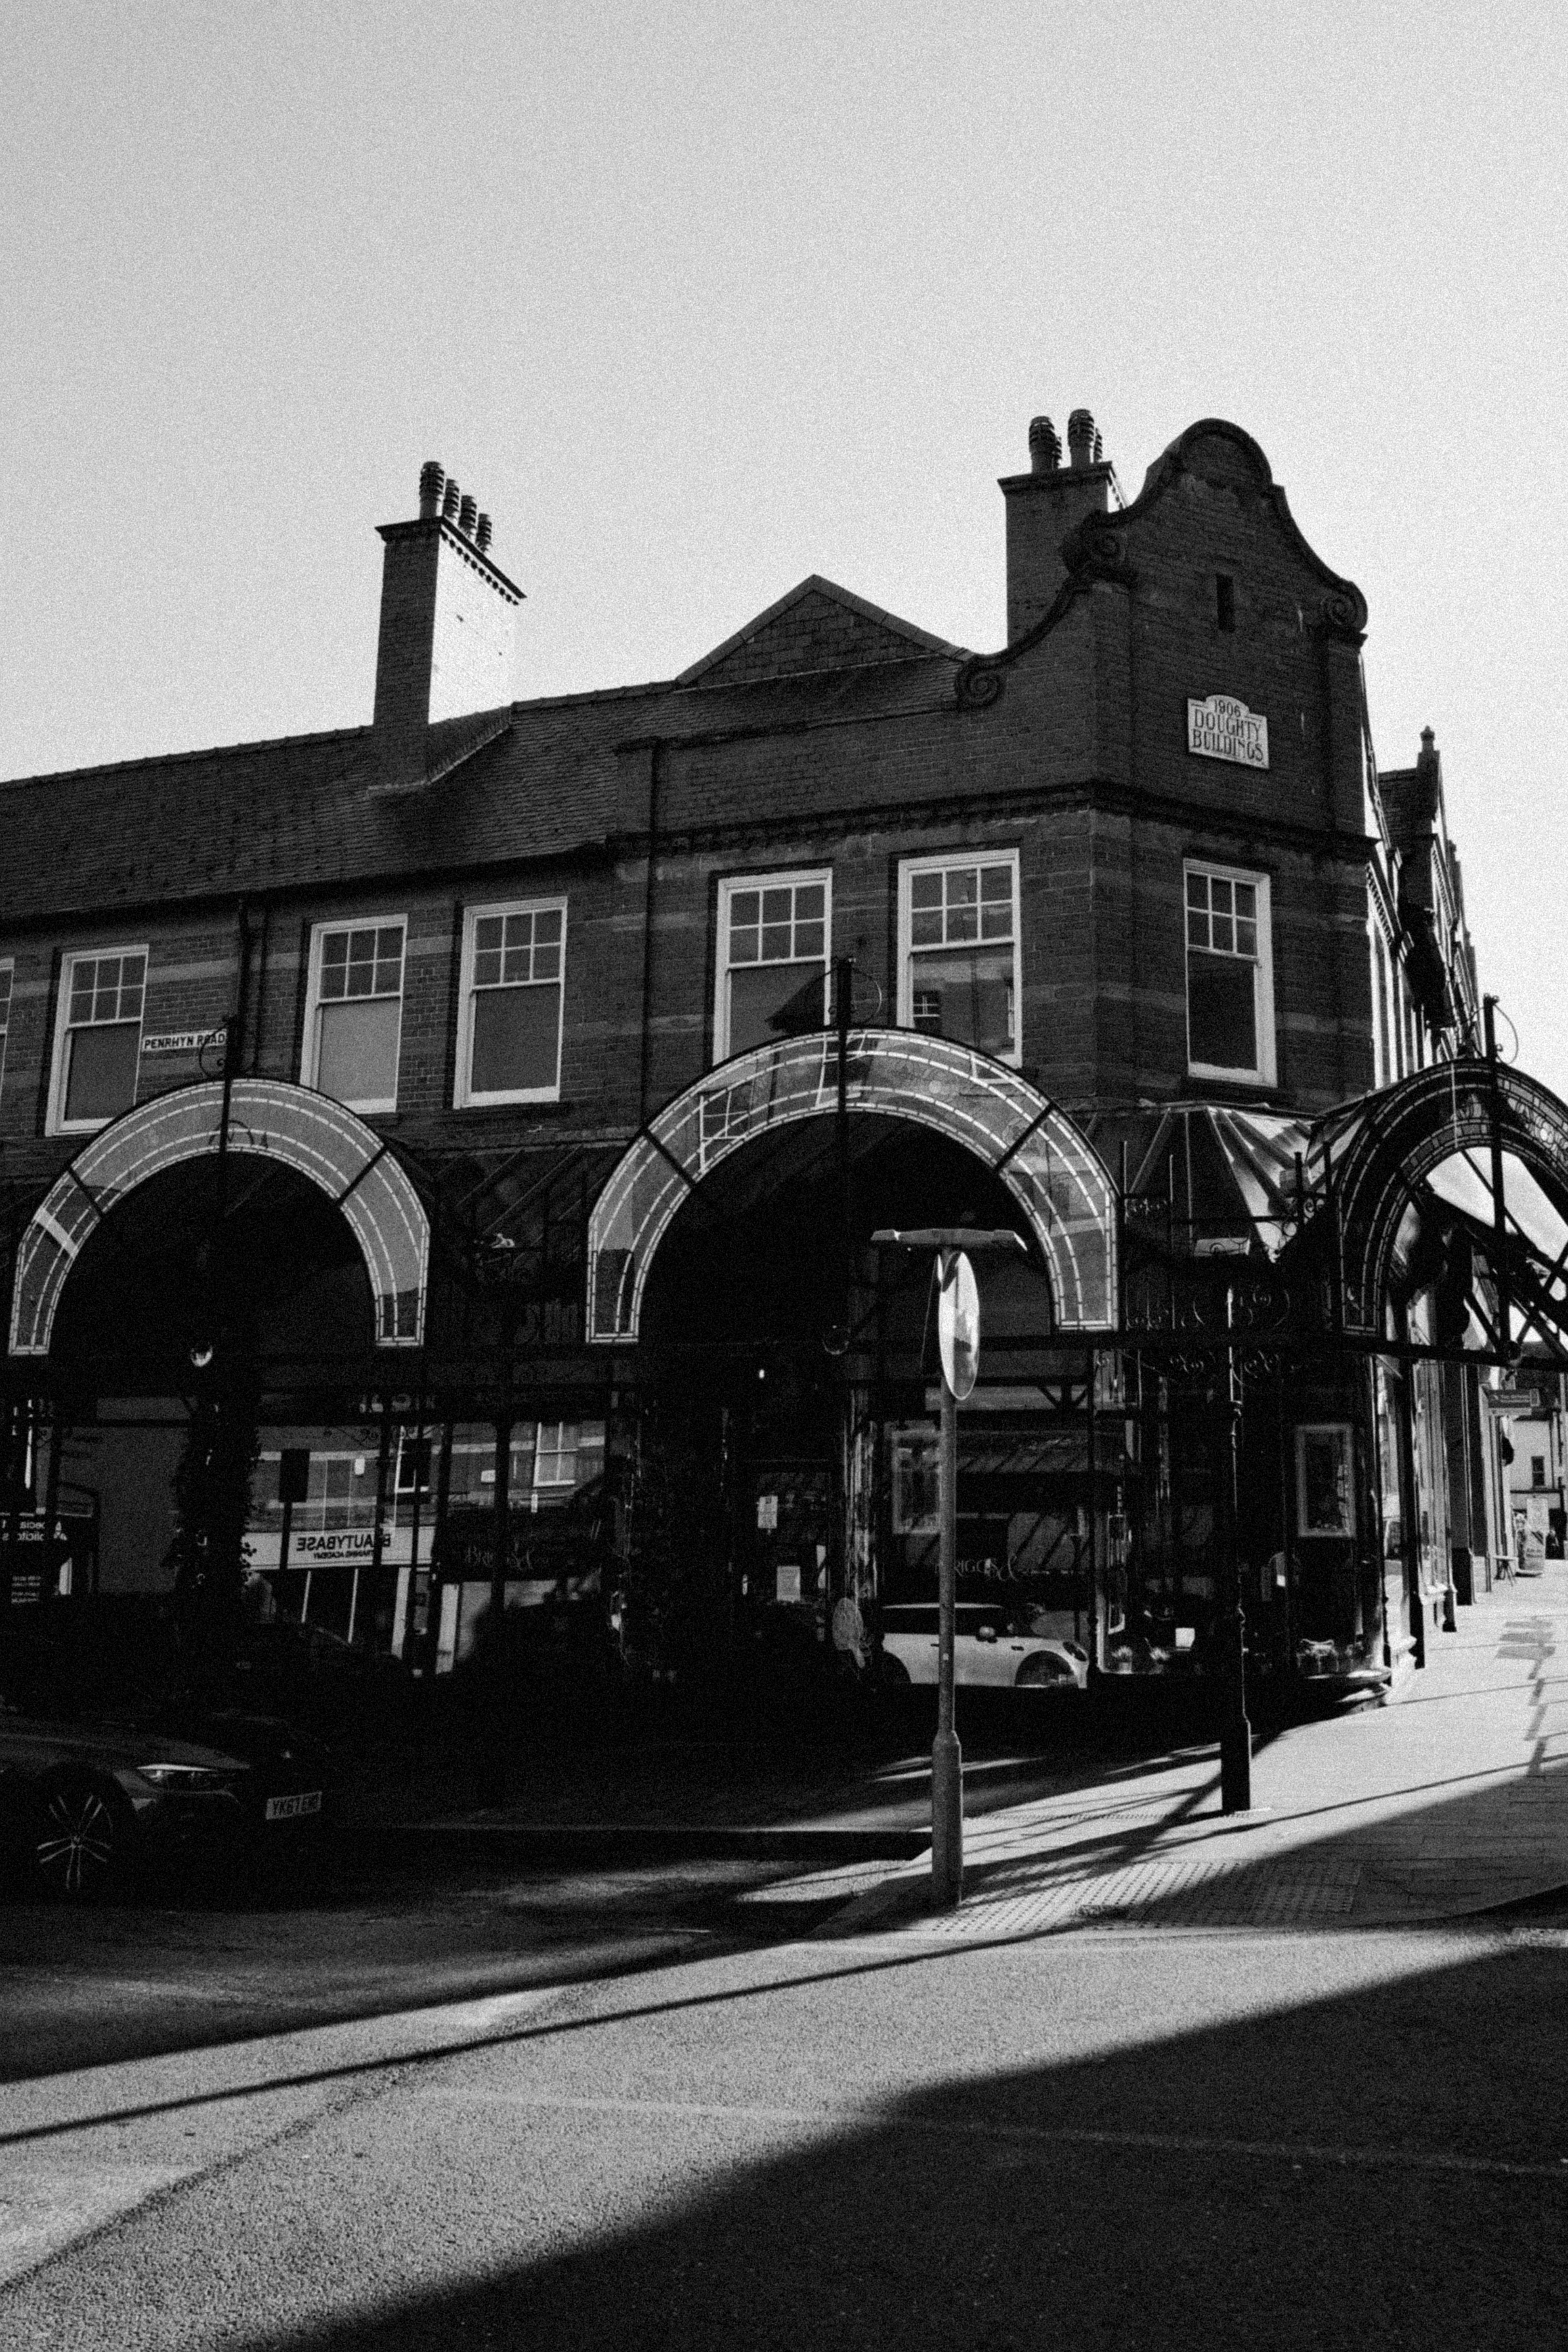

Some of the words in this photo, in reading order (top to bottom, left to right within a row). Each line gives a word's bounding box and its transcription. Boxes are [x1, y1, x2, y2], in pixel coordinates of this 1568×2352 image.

[1213, 699, 1241, 718] 1906
[1195, 708, 1261, 741] DOUGHTY
[1193, 728, 1263, 761] BUILDINGS
[144, 1035, 193, 1049] PENRHYN
[197, 1033, 226, 1045] ROAD
